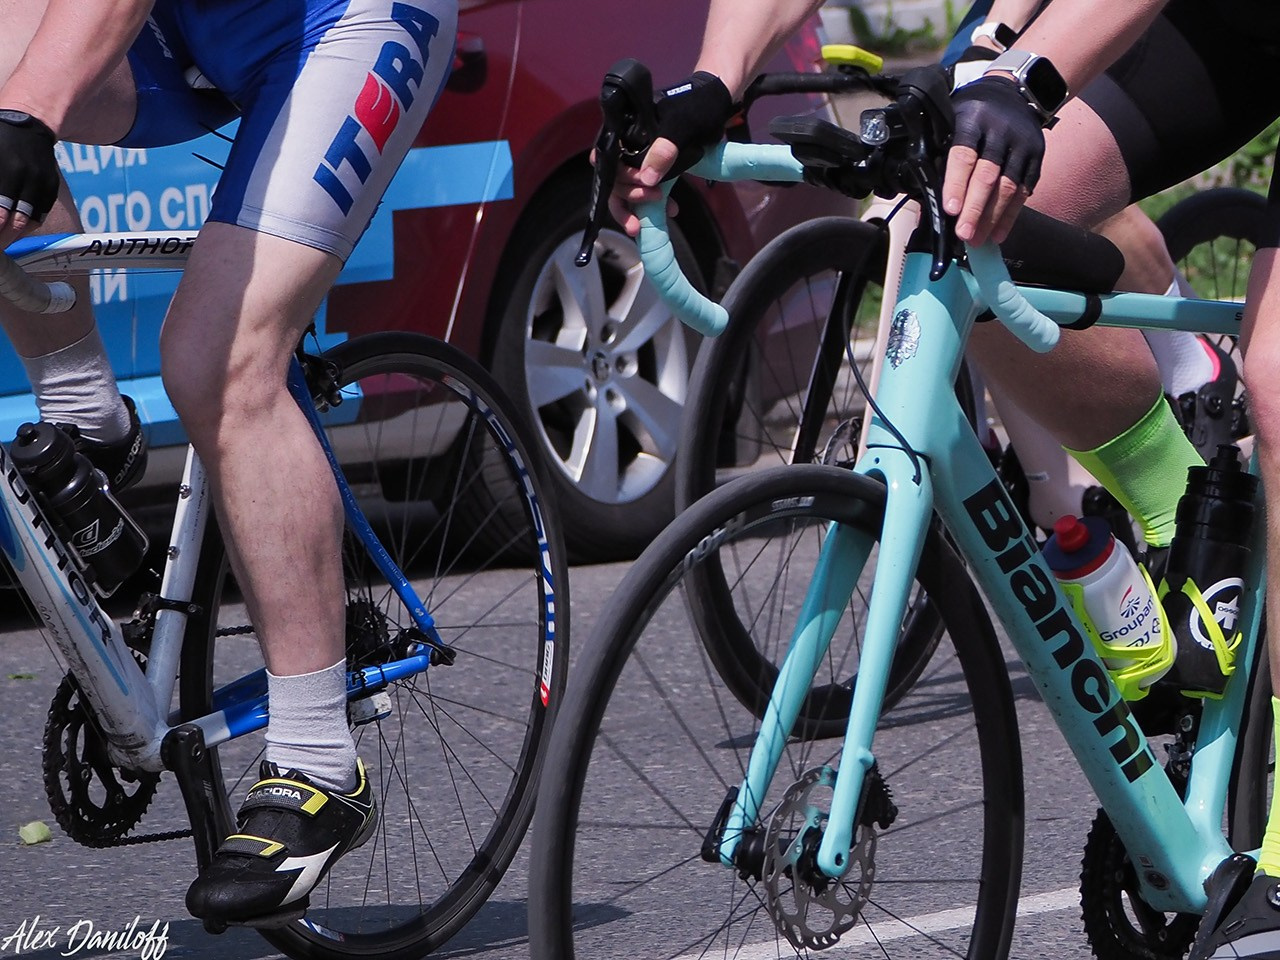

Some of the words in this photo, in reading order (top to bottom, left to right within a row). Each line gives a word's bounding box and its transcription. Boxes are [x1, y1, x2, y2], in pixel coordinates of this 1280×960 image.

[54, 142, 148, 175] АЦИЯ
[79, 190, 152, 234] ОГО
[160, 182, 217, 230] СП
[114, 430, 142, 485] DIADOR
[961, 476, 1158, 784] Bianchi
